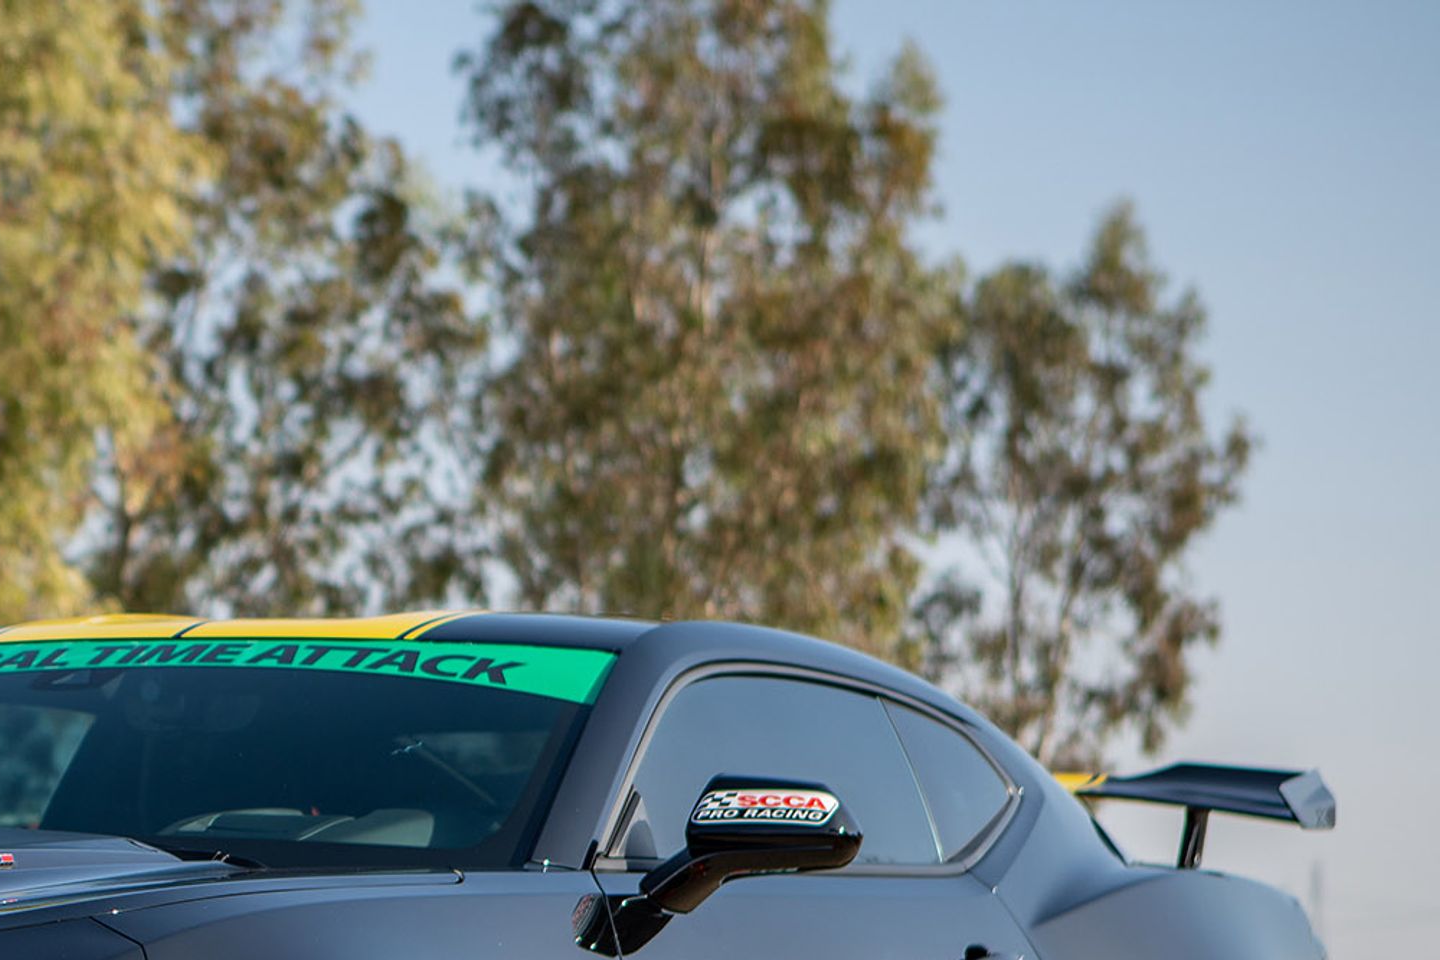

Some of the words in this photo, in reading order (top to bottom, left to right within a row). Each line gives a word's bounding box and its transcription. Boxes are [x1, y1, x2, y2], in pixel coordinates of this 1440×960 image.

[86, 642, 259, 666] TIME
[249, 643, 528, 685] ATTACK
[738, 795, 827, 811] SCCA
[697, 809, 739, 820] PRO
[743, 808, 823, 821] RACING
